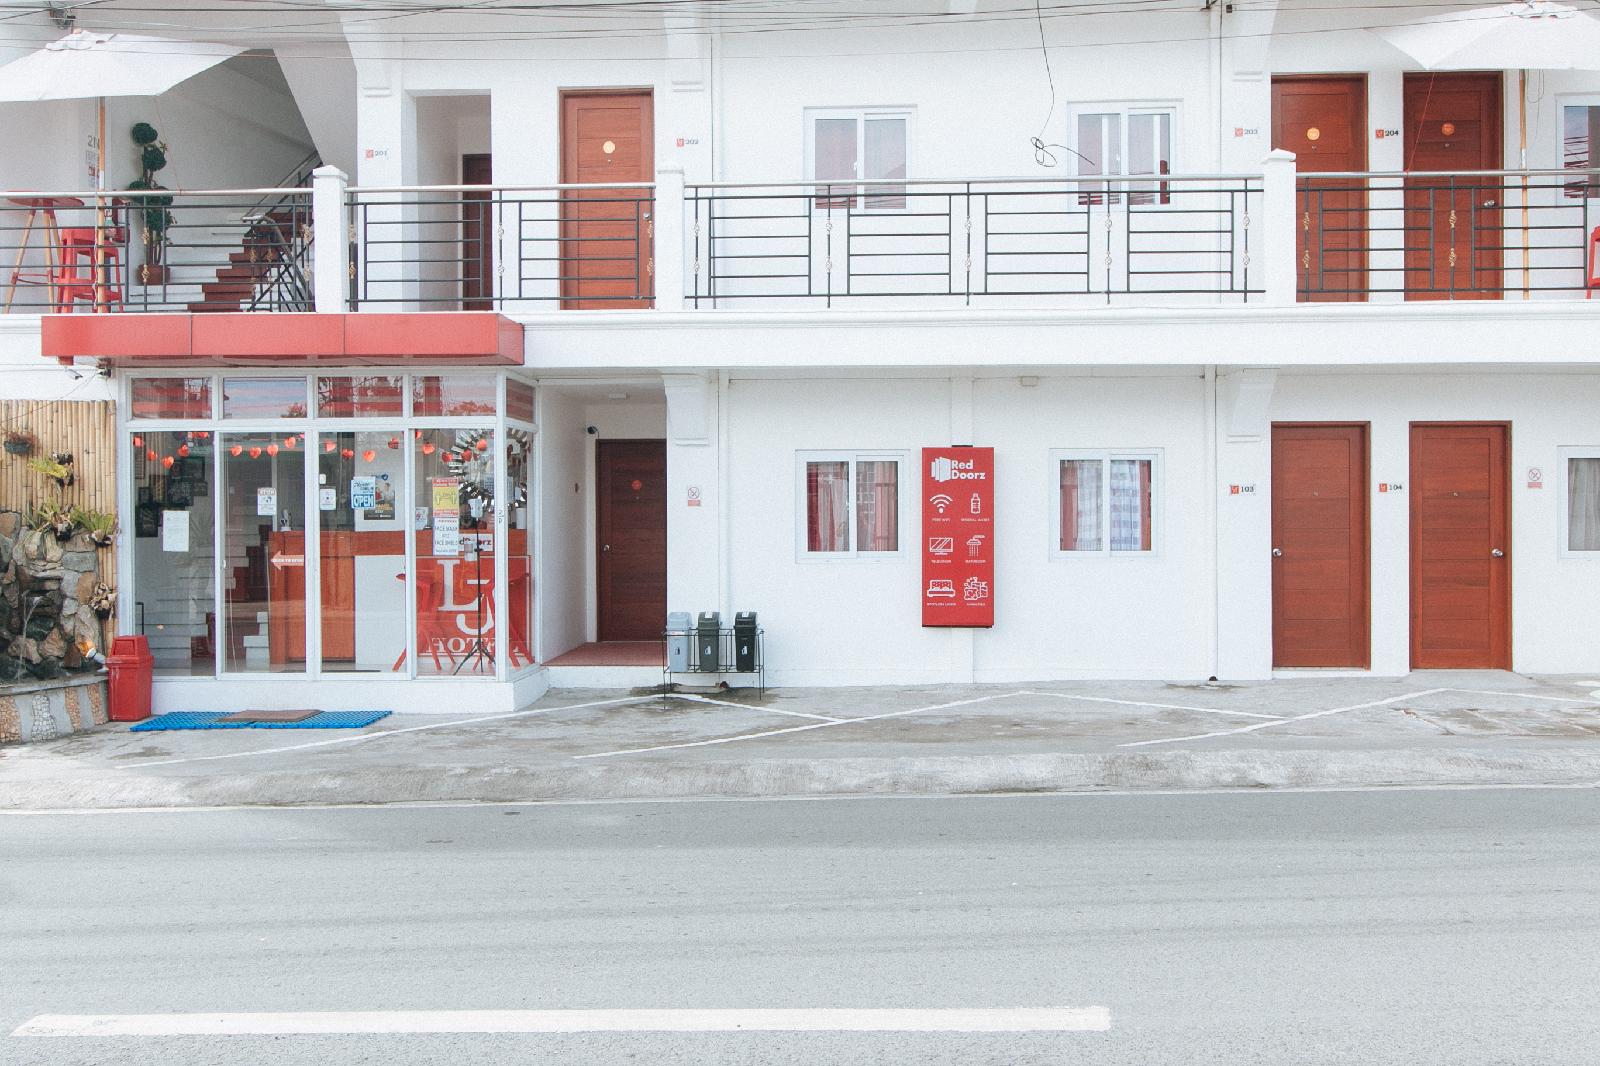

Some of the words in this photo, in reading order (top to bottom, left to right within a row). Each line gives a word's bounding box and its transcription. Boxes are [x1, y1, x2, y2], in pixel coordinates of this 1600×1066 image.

[951, 459, 974, 470] Red
[951, 470, 986, 480] Doorz
[353, 495, 375, 507] OPEN
